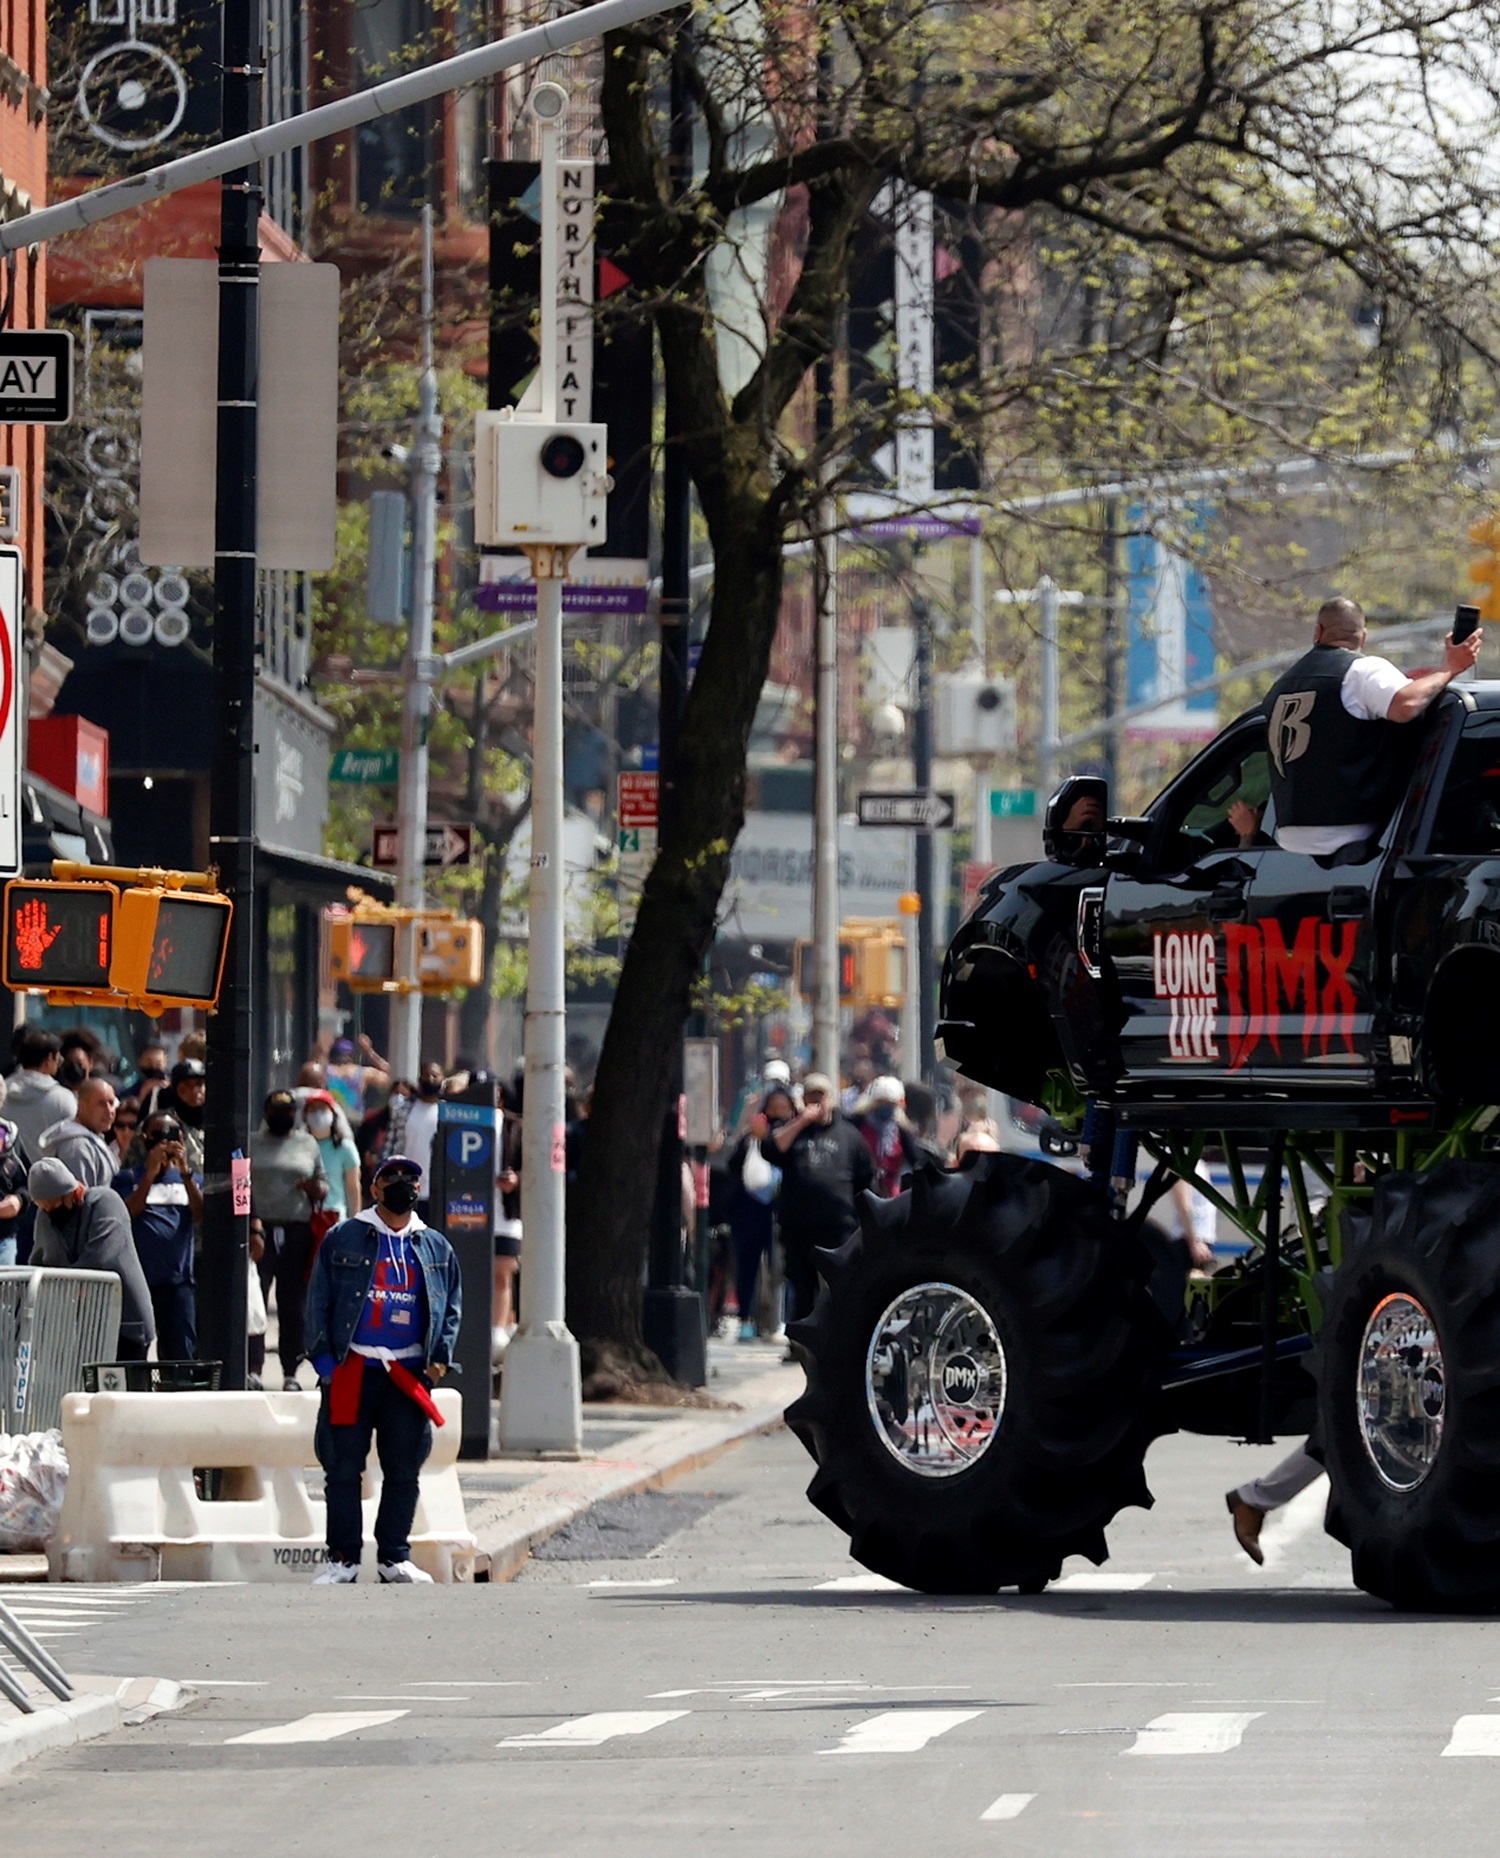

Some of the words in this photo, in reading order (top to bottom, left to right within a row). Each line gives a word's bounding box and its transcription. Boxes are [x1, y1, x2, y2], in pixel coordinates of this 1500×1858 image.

[561, 169, 582, 296] NORTH
[0, 360, 48, 393] AY
[560, 314, 581, 417] FLAT
[1153, 929, 1218, 997] LONG
[1222, 916, 1360, 1074] DMX
[1168, 996, 1220, 1059] LIVE
[235, 1195, 249, 1207] SA
[16, 1344, 29, 1410] NYPD
[945, 1366, 977, 1390] DMX
[273, 1547, 330, 1565] YODOCK
